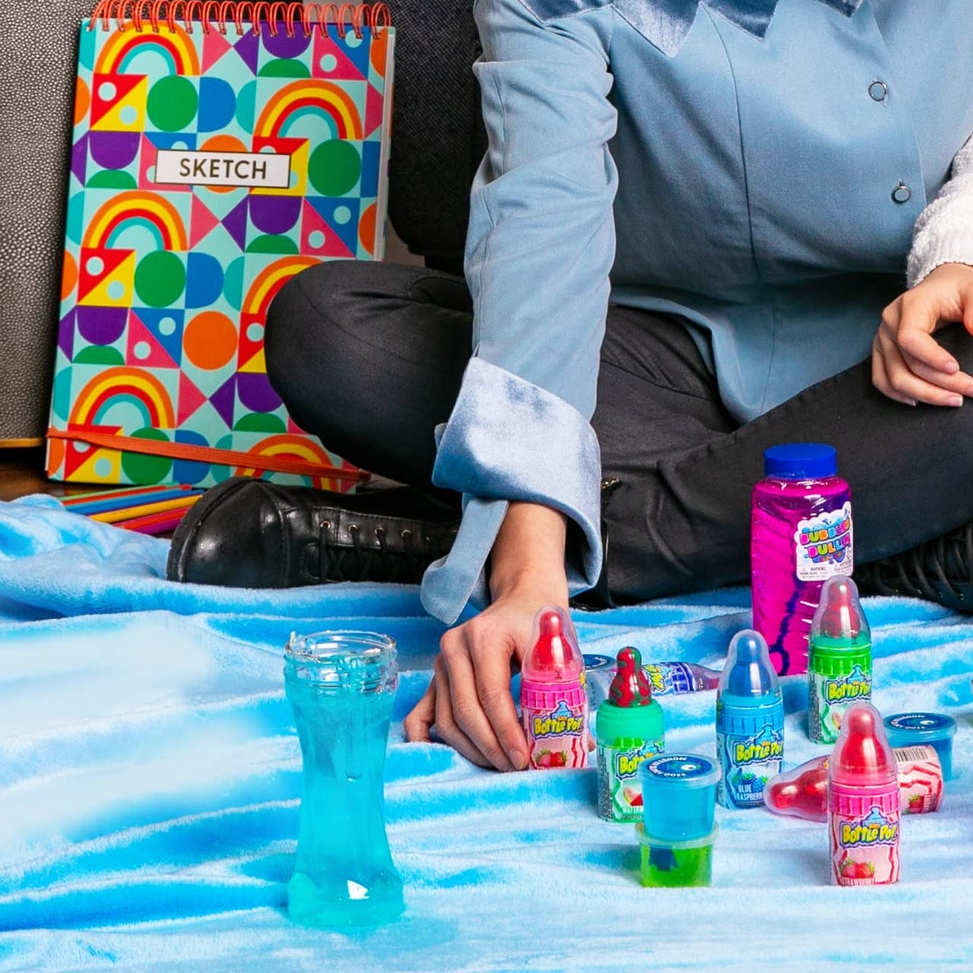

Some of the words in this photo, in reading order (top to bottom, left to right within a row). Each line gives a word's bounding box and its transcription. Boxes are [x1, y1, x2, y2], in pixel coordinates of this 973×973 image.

[179, 158, 266, 180] SKETCH
[534, 717, 566, 735] BOTTLE
[736, 743, 769, 762] BOTTLE
[843, 824, 878, 843] BOTTLE
